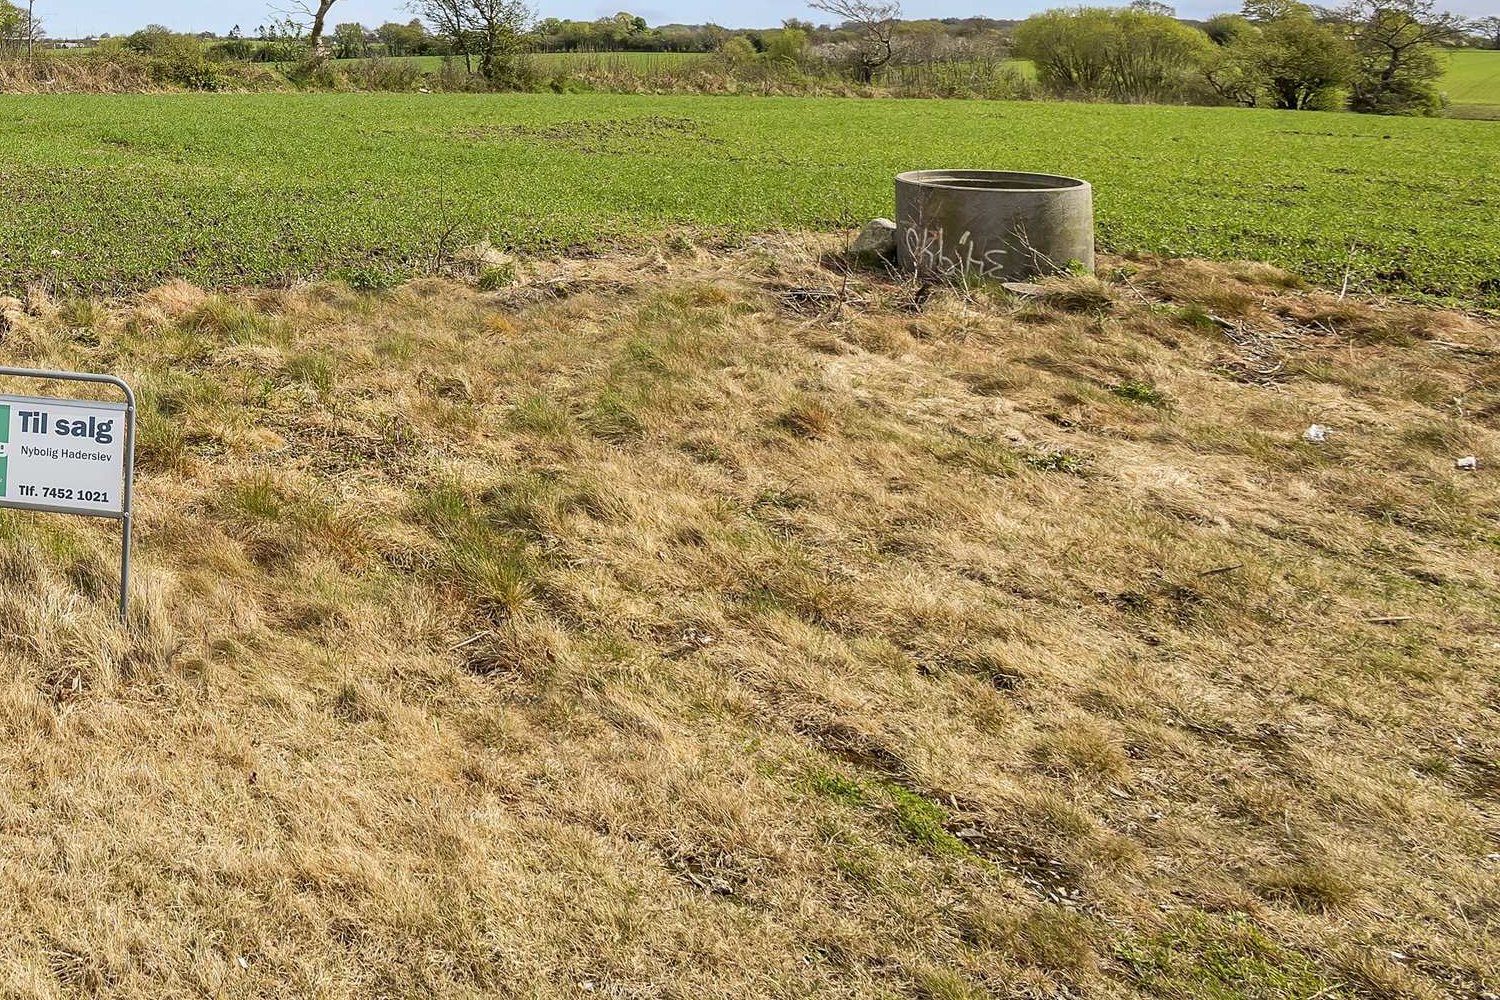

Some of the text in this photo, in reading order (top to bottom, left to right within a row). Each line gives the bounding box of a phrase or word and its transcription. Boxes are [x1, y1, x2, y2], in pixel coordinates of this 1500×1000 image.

[18, 410, 114, 444] Til salg
[21, 445, 112, 462] Nybolig Haderslev
[18, 485, 109, 503] Tlf. 7452 1021
